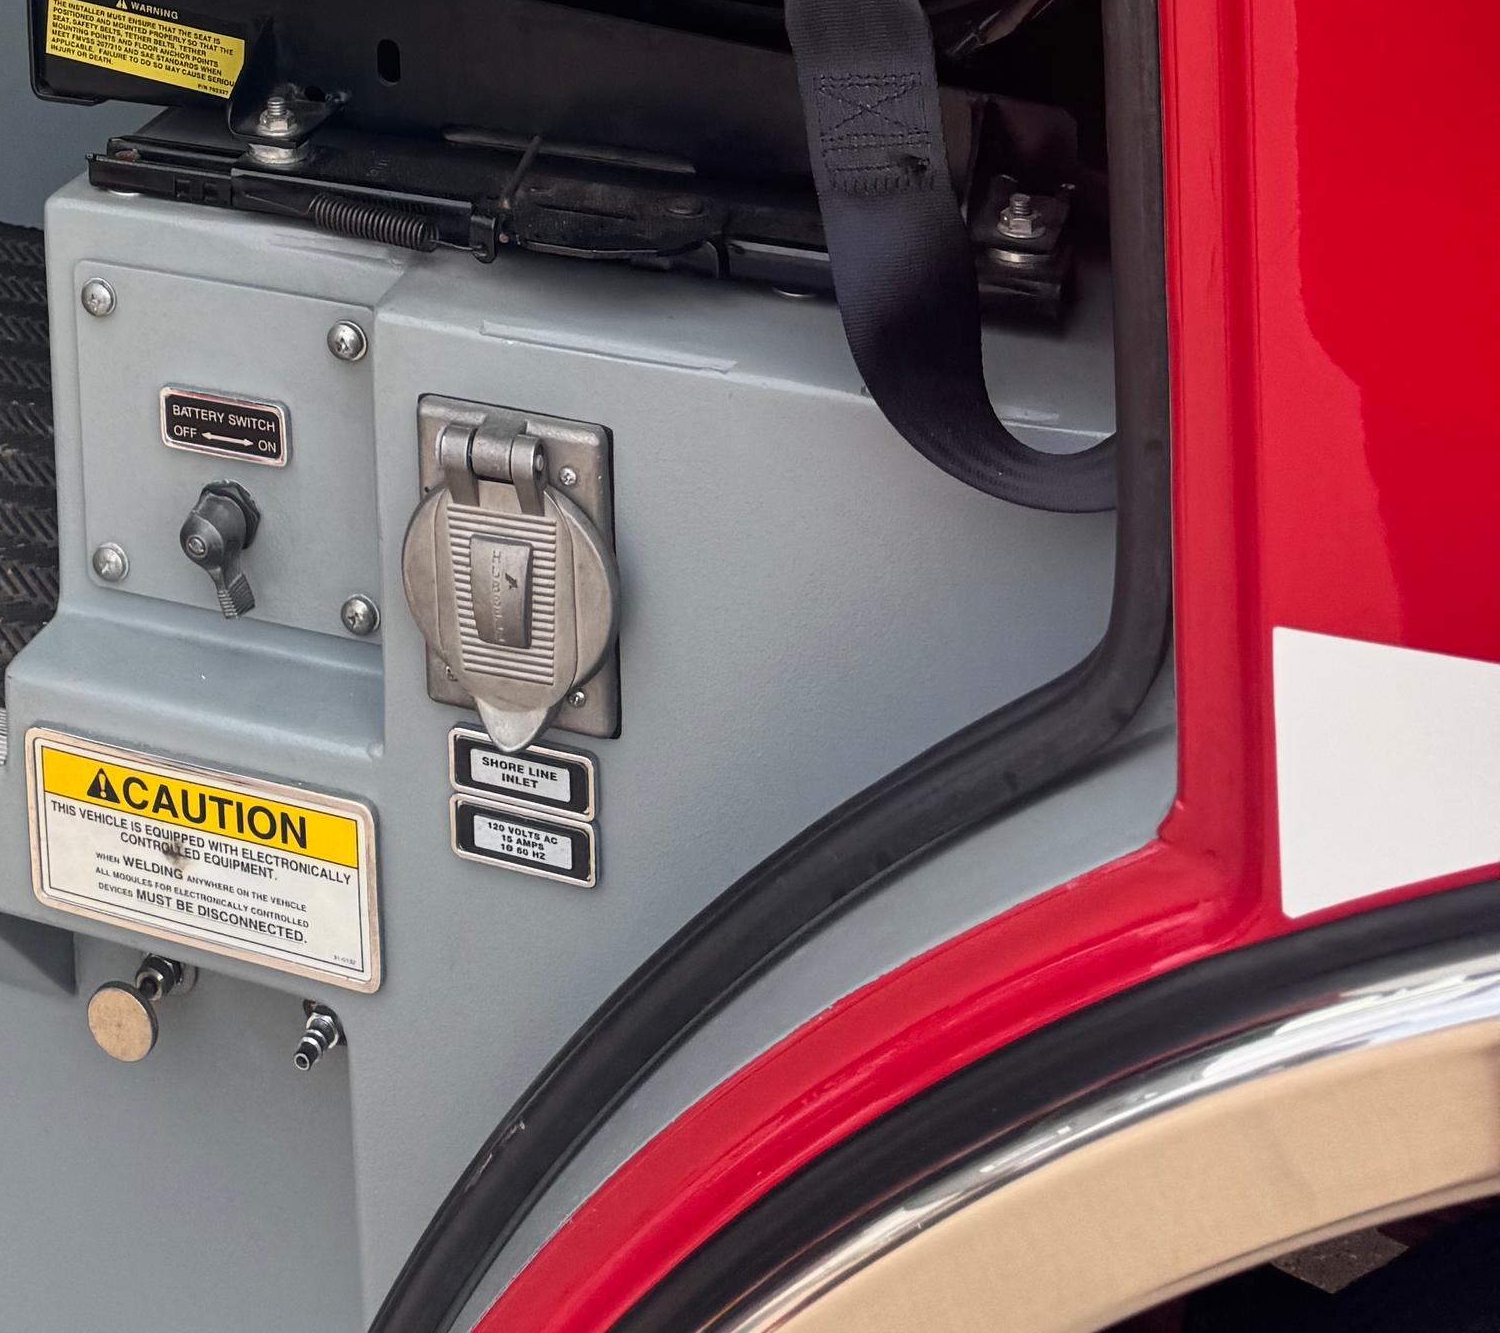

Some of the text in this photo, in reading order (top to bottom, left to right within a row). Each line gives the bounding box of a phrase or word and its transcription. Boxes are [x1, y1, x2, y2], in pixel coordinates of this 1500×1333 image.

[68, 2, 105, 16] INSTALLER
[107, 12, 126, 21] MUST
[128, 17, 156, 29] ENSURE
[158, 24, 175, 33] THAT
[178, 29, 192, 37] THE
[194, 33, 211, 42] SEAT
[131, 1, 178, 20] WARNING
[52, 21, 219, 68] MOUNTING POINTS AND FLOOR ANCHOR POINTS
[53, 7, 234, 56] POSITIONED AND MOUNTED PROPERLY SO THAT THE
[72, 19, 98, 30] SAFETY
[124, 31, 152, 44] TETHER
[179, 44, 206, 57] TETHER
[51, 44, 75, 56] INJURY
[77, 50, 88, 58] OR
[52, 29, 70, 38] MEET
[72, 33, 95, 45] FMVSS
[124, 47, 138, 56] AND
[140, 51, 155, 60] SAE
[156, 55, 199, 71] STANDARDS
[200, 65, 222, 76] WHEN
[98, 48, 127, 61] FAILURE
[129, 55, 139, 64] TO
[152, 61, 163, 70] SO
[165, 64, 181, 74] MAY
[181, 69, 206, 80] CAUSE
[172, 404, 276, 433] BATTERY SWITCH
[173, 424, 277, 453] OFF ON
[482, 756, 558, 781] SHORE LINE
[501, 773, 539, 789] INLET
[121, 776, 308, 849] CAUTION
[51, 800, 351, 886] THIS VEHICLE IS EQUIPPED WITH ELECTRONICALLY
[487, 822, 558, 845] 120 VOLTS AC
[501, 834, 545, 851] 15 AMPS
[120, 831, 278, 881] CONTROLLED EQUIPMENT.
[516, 846, 529, 856] 60
[532, 850, 546, 861] HZ
[95, 851, 307, 912] WHEN WELDING ANYWHERE ON THE VEHICLE
[95, 867, 309, 928] ALL MODULES FOR ELECTRONICALLY CONTROLLED
[98, 882, 308, 944] DEVICES MUST BE DISCONNECTED.
